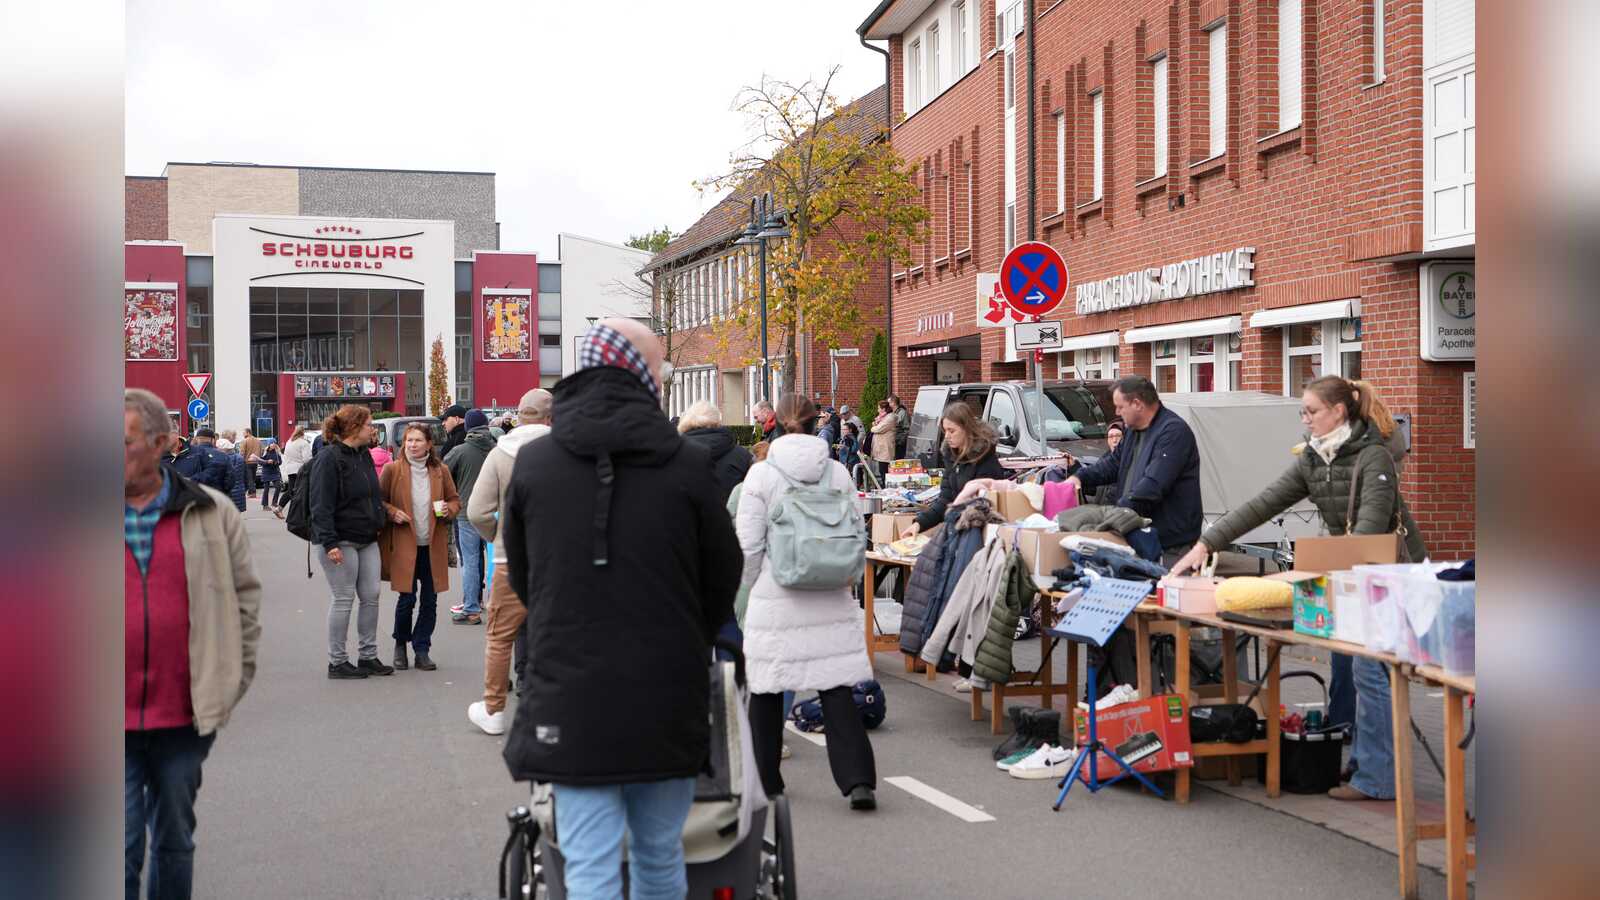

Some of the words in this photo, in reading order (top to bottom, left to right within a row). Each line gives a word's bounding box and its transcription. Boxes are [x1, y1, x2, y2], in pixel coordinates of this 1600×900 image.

[1075, 267, 1159, 315] PARACELSUS
[1159, 247, 1256, 300] APOTHEKE
[1443, 291, 1475, 300] BAYE
[1458, 276, 1467, 316] BAYER
[1441, 339, 1475, 350] Apothe
